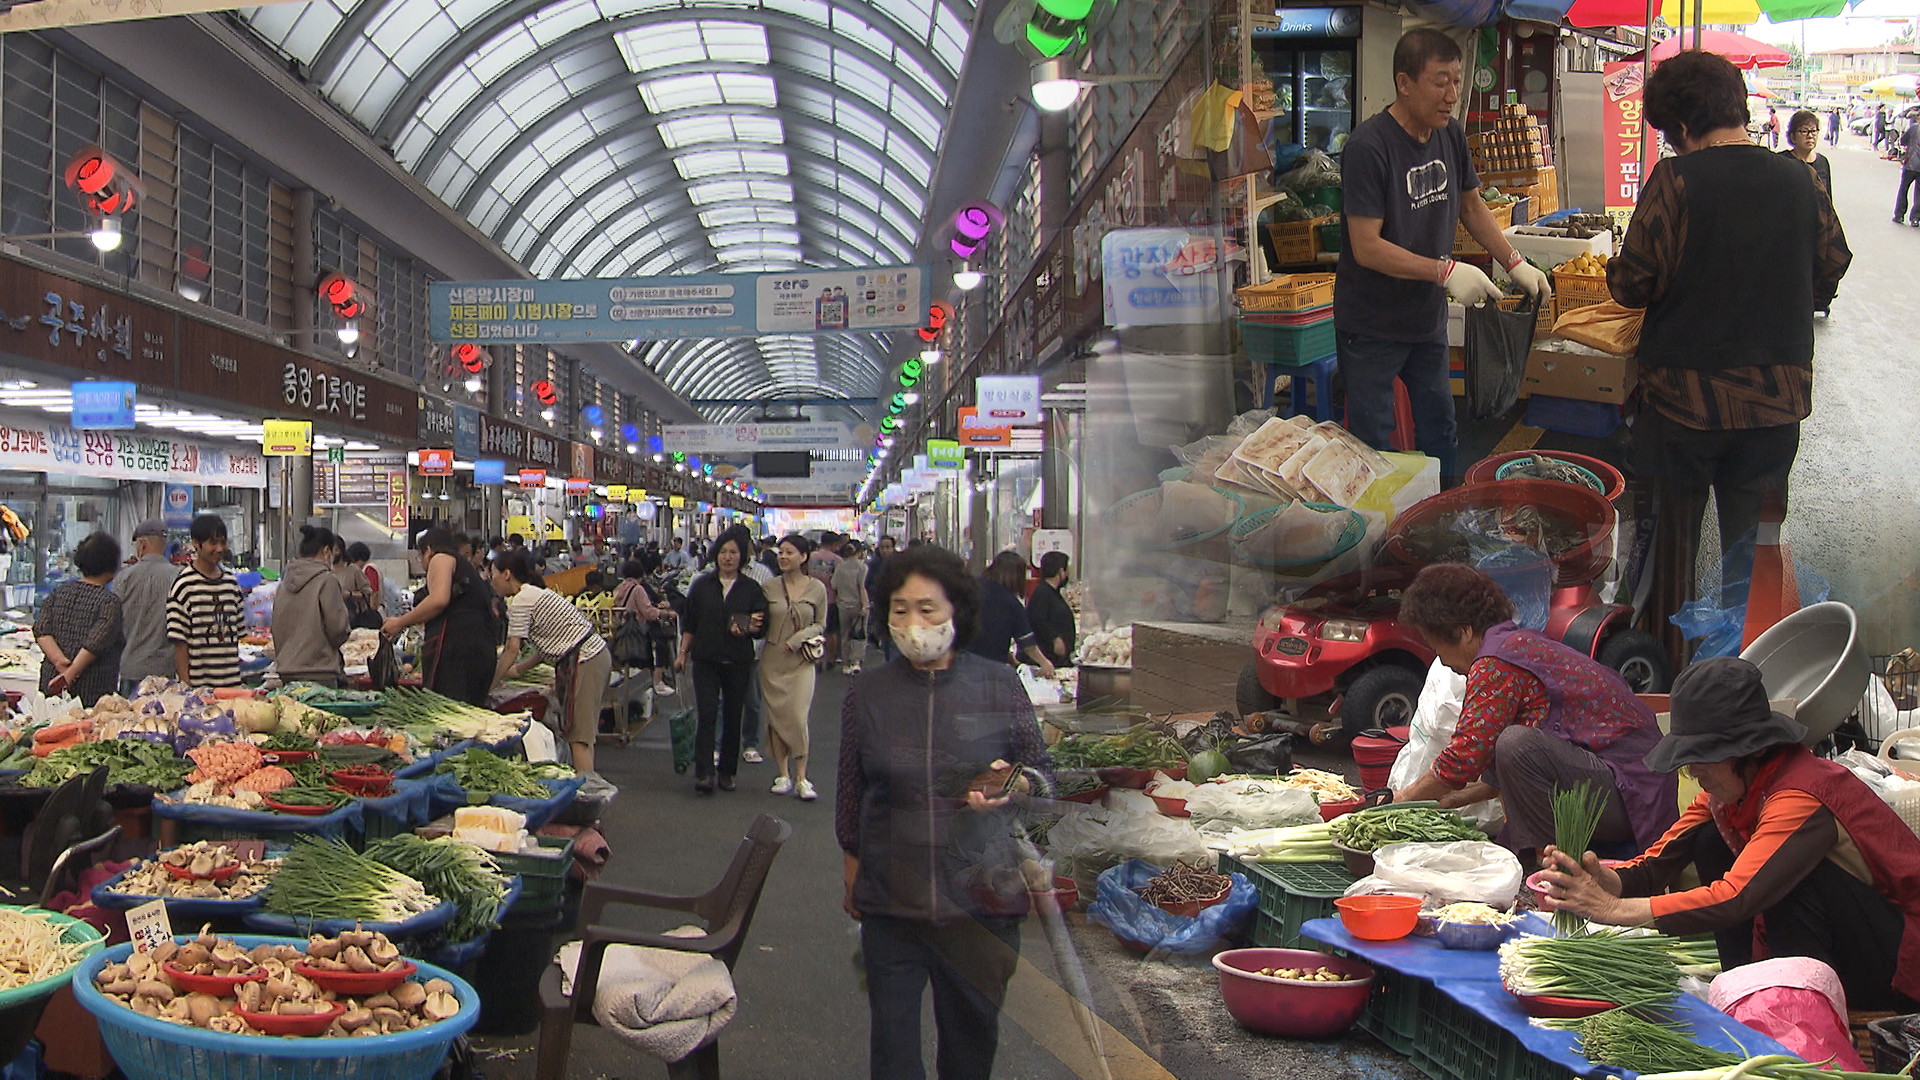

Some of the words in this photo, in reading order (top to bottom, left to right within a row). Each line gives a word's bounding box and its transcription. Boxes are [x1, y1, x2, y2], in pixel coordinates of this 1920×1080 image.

[1282, 22, 1313, 32] Drinks
[1617, 99, 1643, 161] 양고기
[773, 279, 811, 291] zero
[449, 287, 535, 304] 신중앙시장이
[449, 304, 508, 320] 제로페이
[512, 303, 598, 320] 시범시장으로
[39, 291, 132, 362] 공주상회
[450, 323, 539, 339] 선정되었습니다
[283, 363, 366, 420] 중앙그릇마트
[391, 475, 406, 526] 돈까스
